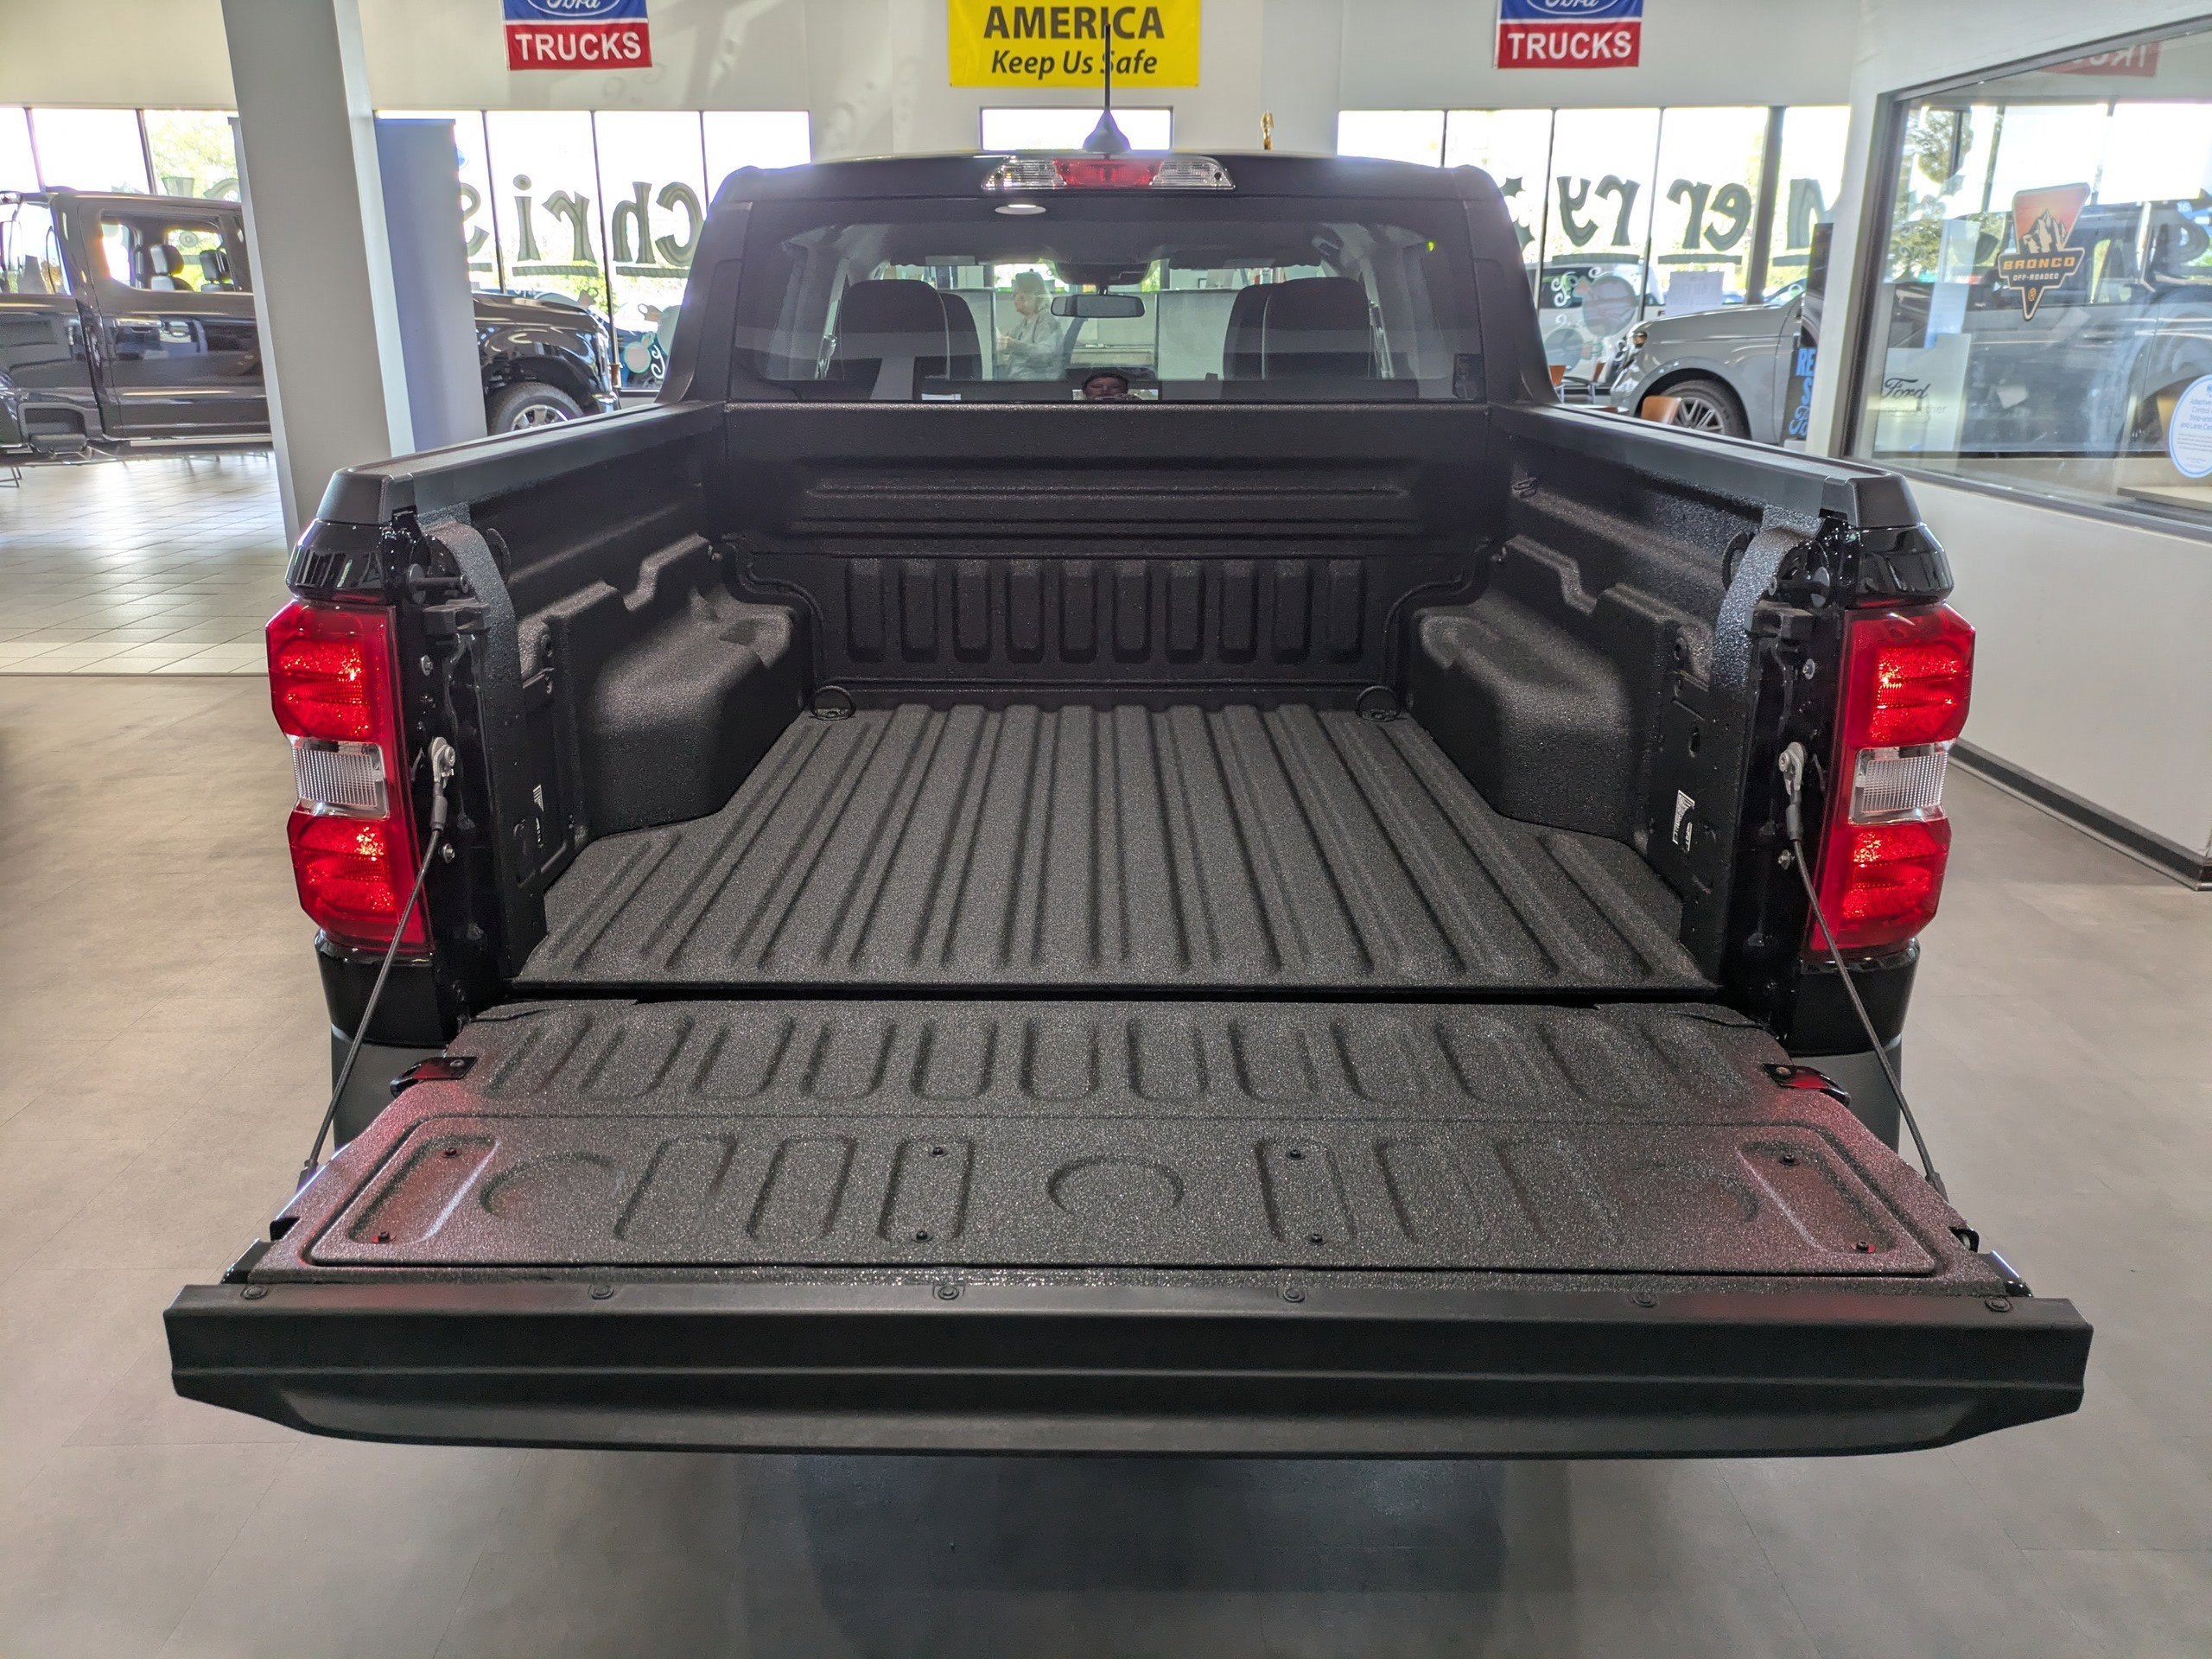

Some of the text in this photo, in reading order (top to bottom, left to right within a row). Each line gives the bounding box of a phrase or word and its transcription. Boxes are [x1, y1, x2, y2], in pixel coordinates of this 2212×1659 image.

[984, 6, 1165, 40] AMERICA
[515, 32, 642, 61] TRUCKS
[1507, 30, 1632, 60] TRUCKS
[991, 50, 1056, 79] Keep
[1063, 50, 1093, 74] Us
[2003, 257, 2075, 270] BRONCO
[1881, 378, 1931, 400] Ford
